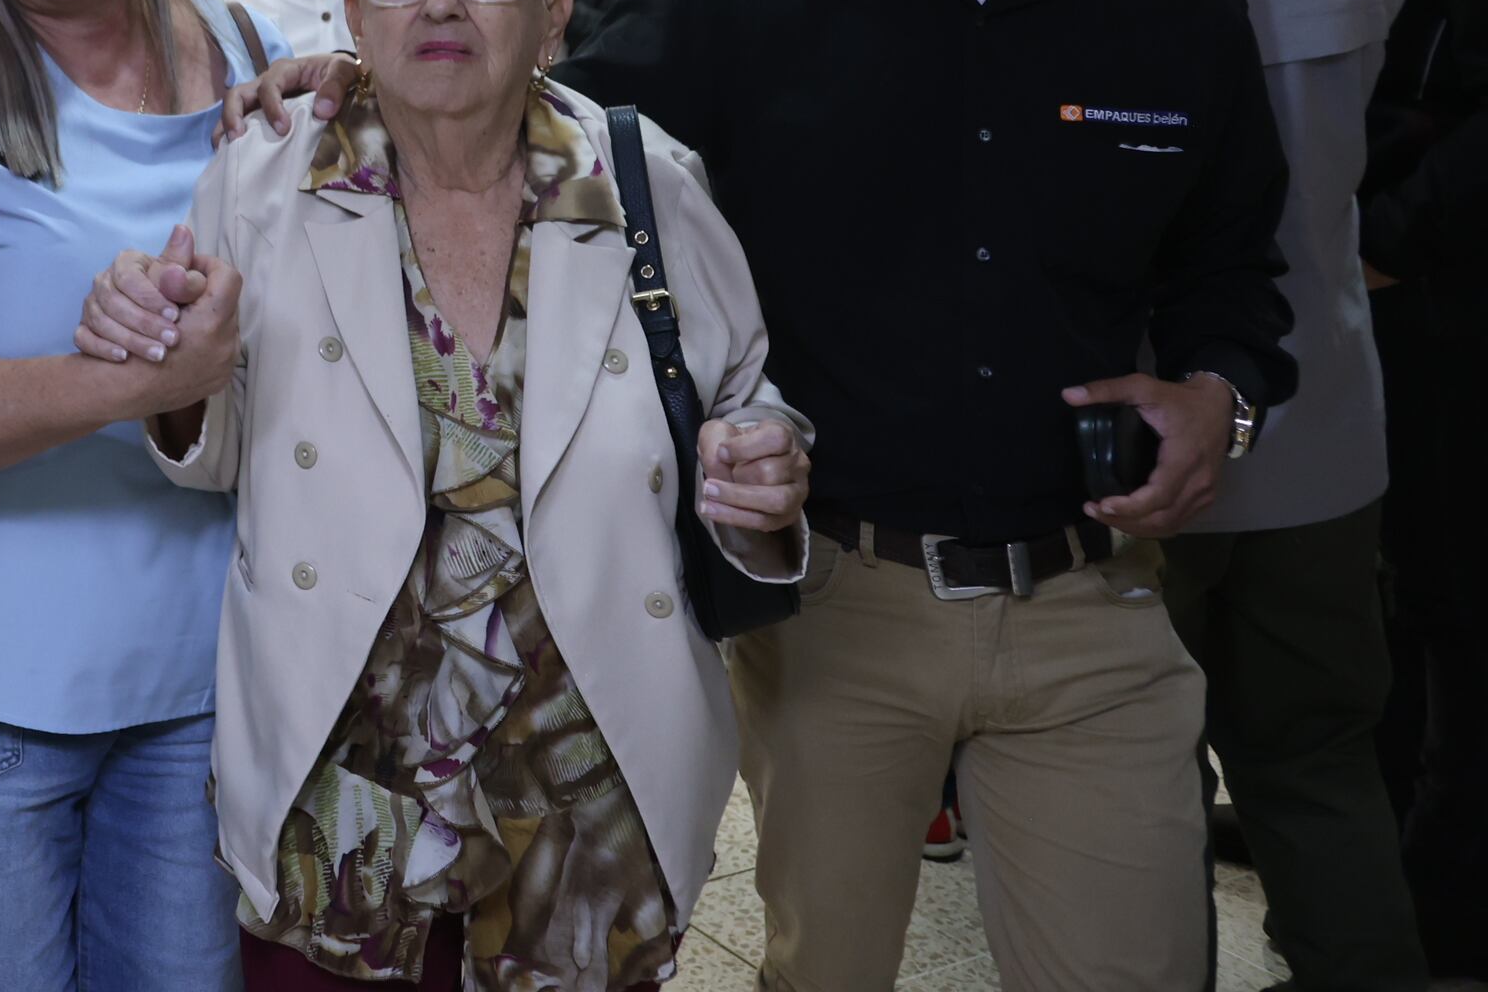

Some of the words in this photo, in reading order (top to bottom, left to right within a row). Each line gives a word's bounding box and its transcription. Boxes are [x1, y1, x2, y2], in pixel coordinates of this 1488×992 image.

[1085, 109, 1152, 123] EMPAQUES
[1153, 111, 1188, 126] belén
[924, 542, 943, 590] TOMMY
